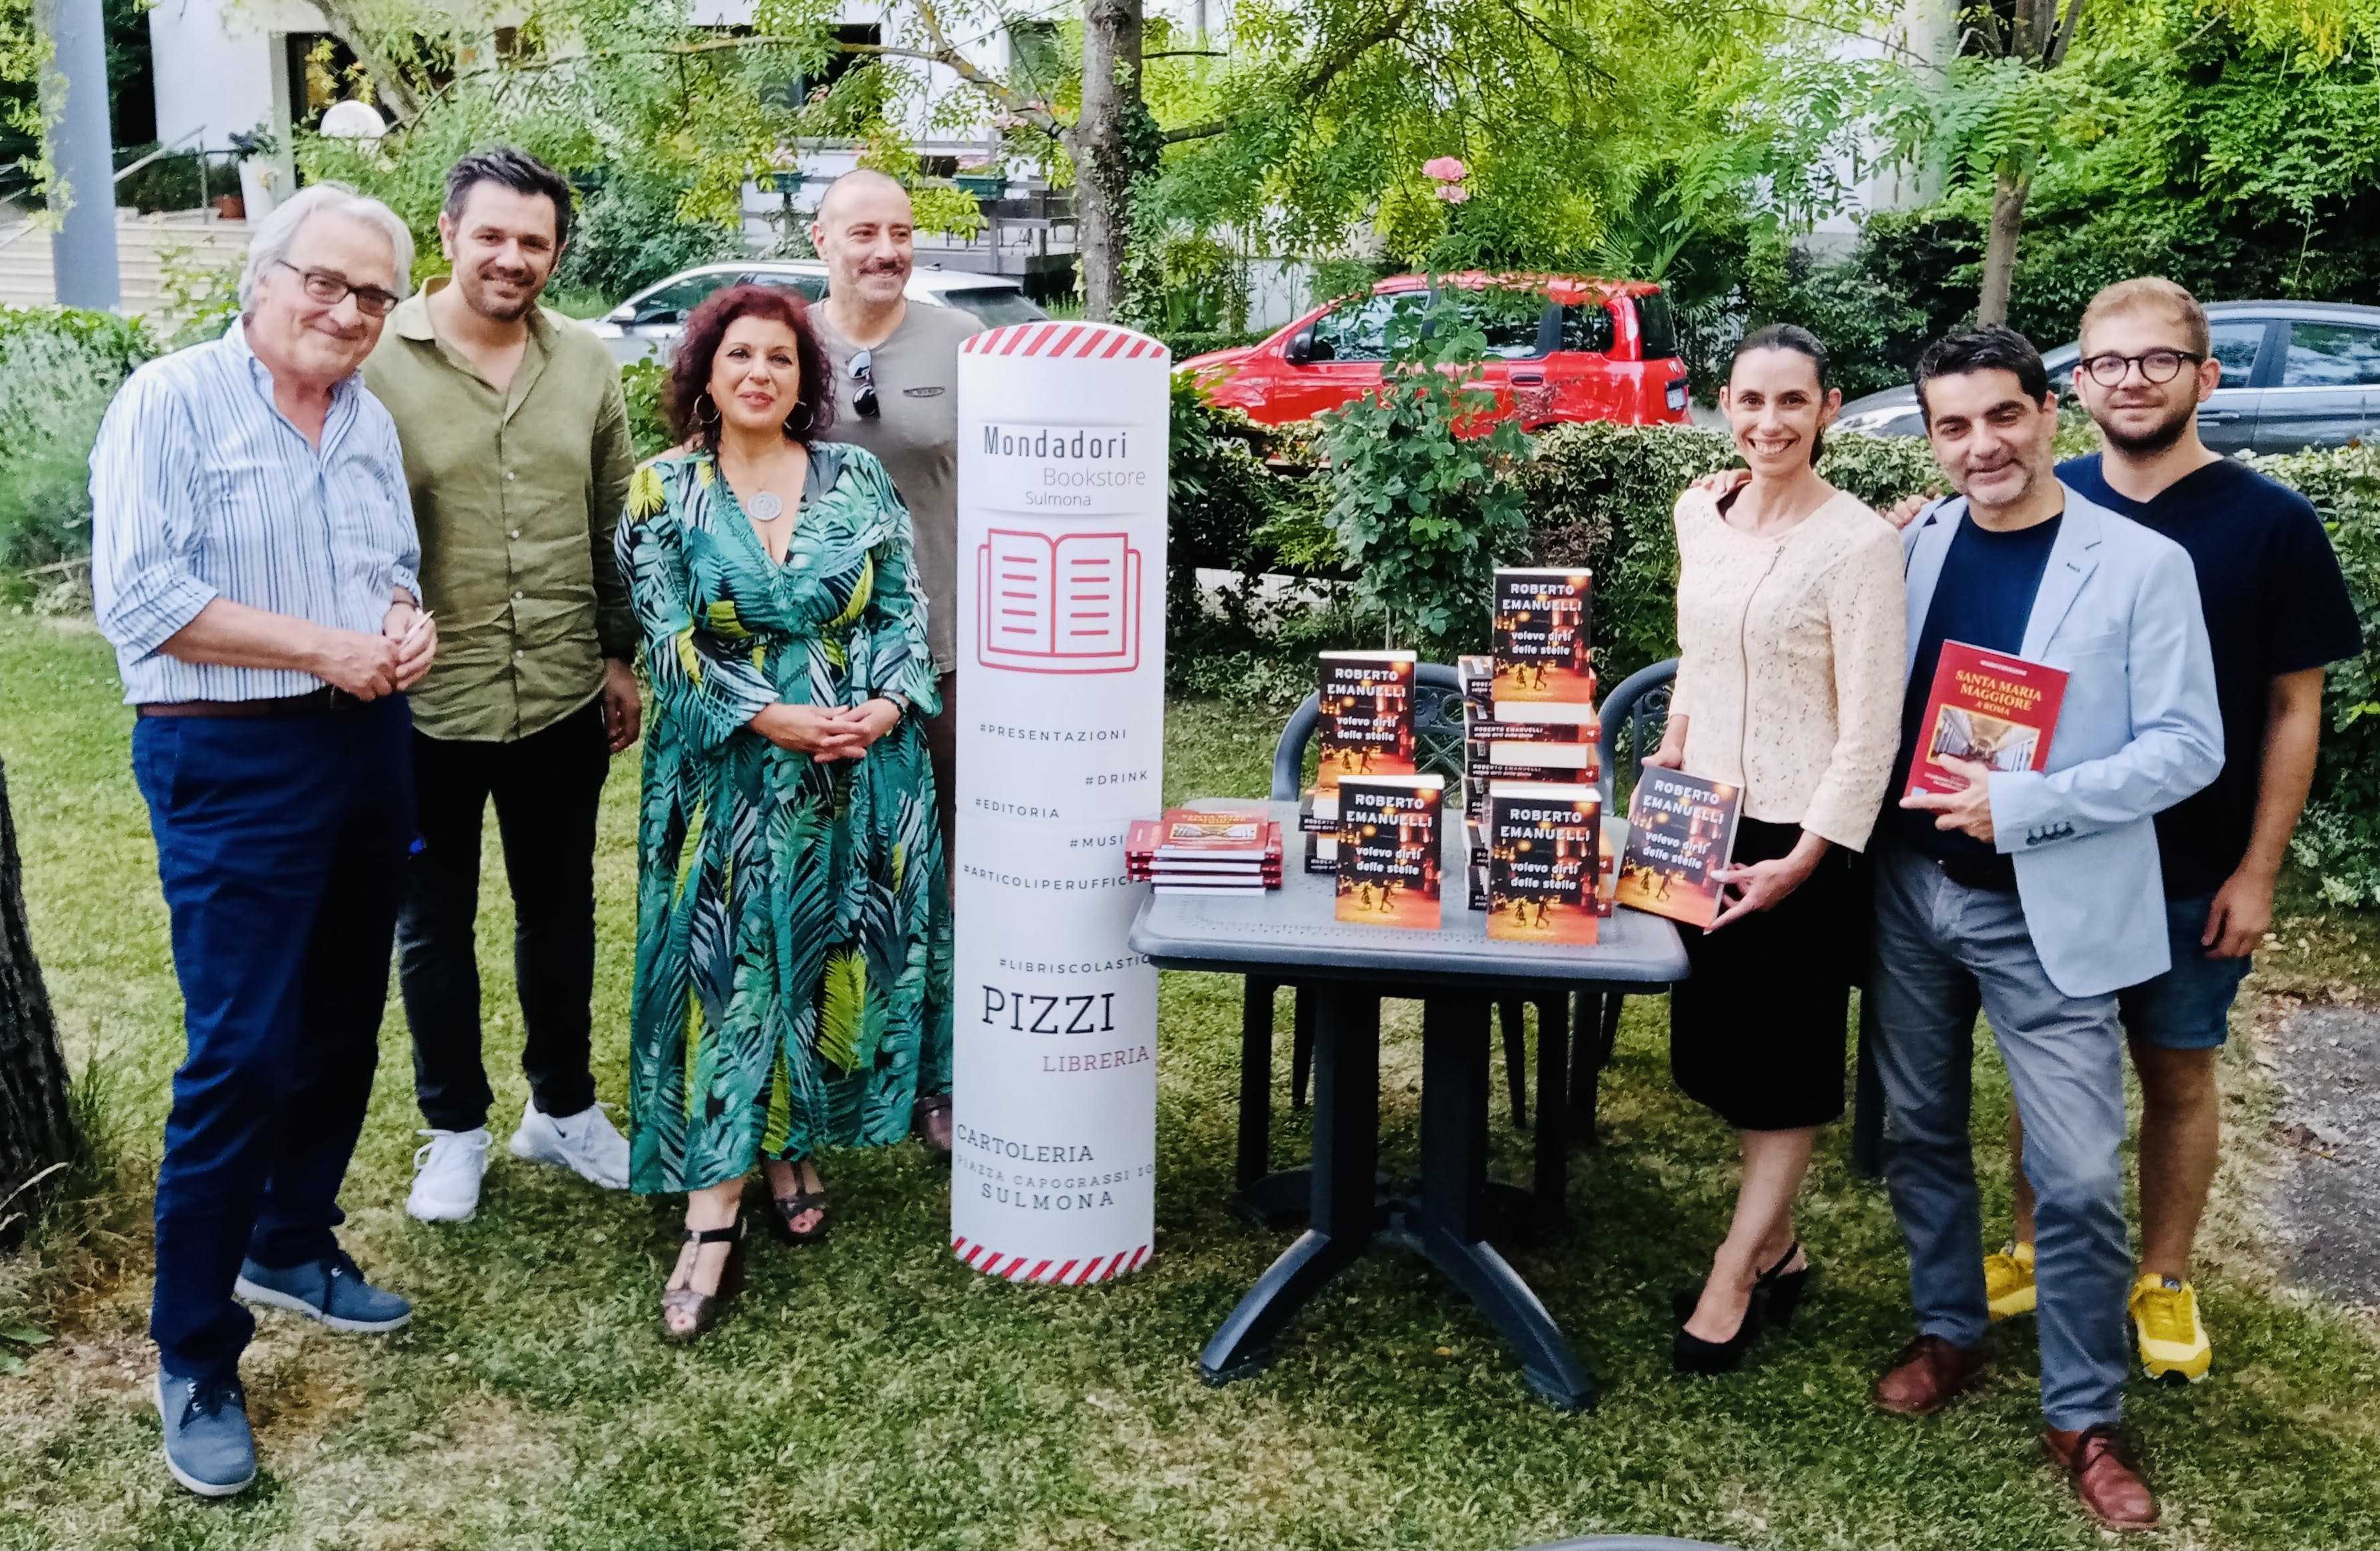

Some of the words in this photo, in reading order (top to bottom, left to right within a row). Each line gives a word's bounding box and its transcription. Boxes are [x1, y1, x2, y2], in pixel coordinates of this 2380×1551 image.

[984, 425, 1127, 458] Mondadori
[1043, 468, 1146, 487] Bookstore
[1025, 491, 1092, 507] Sulmona
[1511, 583, 1574, 596] ROBERTO
[1503, 599, 1582, 611] EMANUELLI
[1511, 630, 1546, 641] volevo
[1512, 643, 1538, 655] delle
[1540, 645, 1570, 655] stelle
[1335, 668, 1399, 682] ROBERTO
[1328, 685, 1406, 697] EMANUELLI
[1956, 670, 1996, 689] SANTA
[1999, 681, 2041, 701] MARIA
[1960, 683, 2031, 711] MAGGIORE
[1983, 703, 2009, 716] ROMA
[1336, 716, 1370, 727] volevo
[980, 723, 1126, 742] #PRESENTAZIONI
[1338, 730, 1364, 741] delle
[1365, 731, 1395, 742] stelle
[1086, 770, 1148, 785] #DRINK
[1654, 780, 1719, 805] ROBERTO
[976, 798, 1059, 819] #EDITORIA
[1356, 794, 1425, 810] ROBERTO
[1643, 795, 1724, 824] EMANUELLI
[1346, 811, 1432, 828] EMANUELLI
[1509, 808, 1582, 823] ROBERTO
[1070, 834, 1124, 848] #MUSI
[1500, 826, 1590, 842] EMANUELLI
[1645, 831, 1680, 848] volevo
[1356, 846, 1393, 859] volevo
[1642, 846, 1669, 861] delle
[1671, 853, 1703, 870] stelle
[1357, 861, 1384, 872] delle
[1387, 864, 1419, 875] stelle
[1511, 861, 1549, 874] volevo
[964, 864, 1142, 890] #ARTICOLIPERUFFIC
[1511, 875, 1541, 888] delle
[1543, 877, 1576, 890] stelle
[981, 985, 1115, 1034] PIZZI
[1042, 1045, 1149, 1072] LIBRERIA
[957, 1124, 1094, 1162] CARTOLERIA
[957, 1154, 1004, 1181] PIAZZA
[1013, 1170, 1129, 1188] CAPOGRASSI
[981, 1182, 1114, 1210] SULMONA
